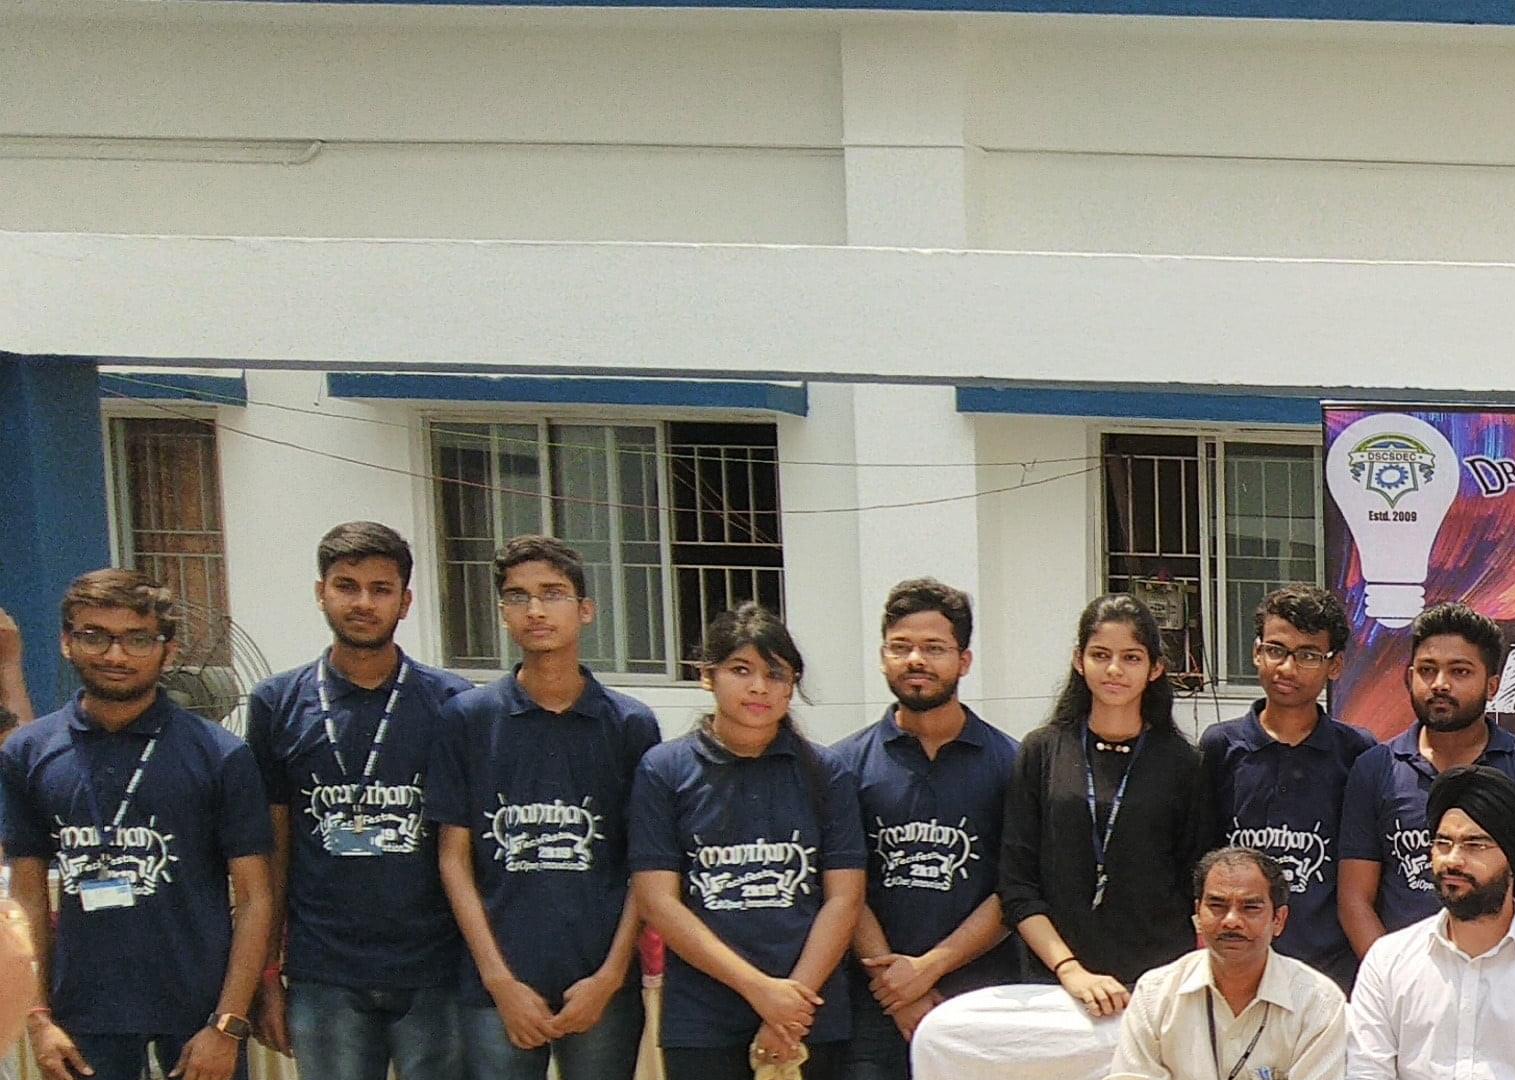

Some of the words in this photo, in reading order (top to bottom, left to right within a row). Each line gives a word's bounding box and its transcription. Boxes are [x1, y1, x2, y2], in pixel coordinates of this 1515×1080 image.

[1367, 451, 1417, 462] DSCSDEC
[1368, 511, 1390, 521] Estd.
[1392, 511, 1417, 522] 2009
